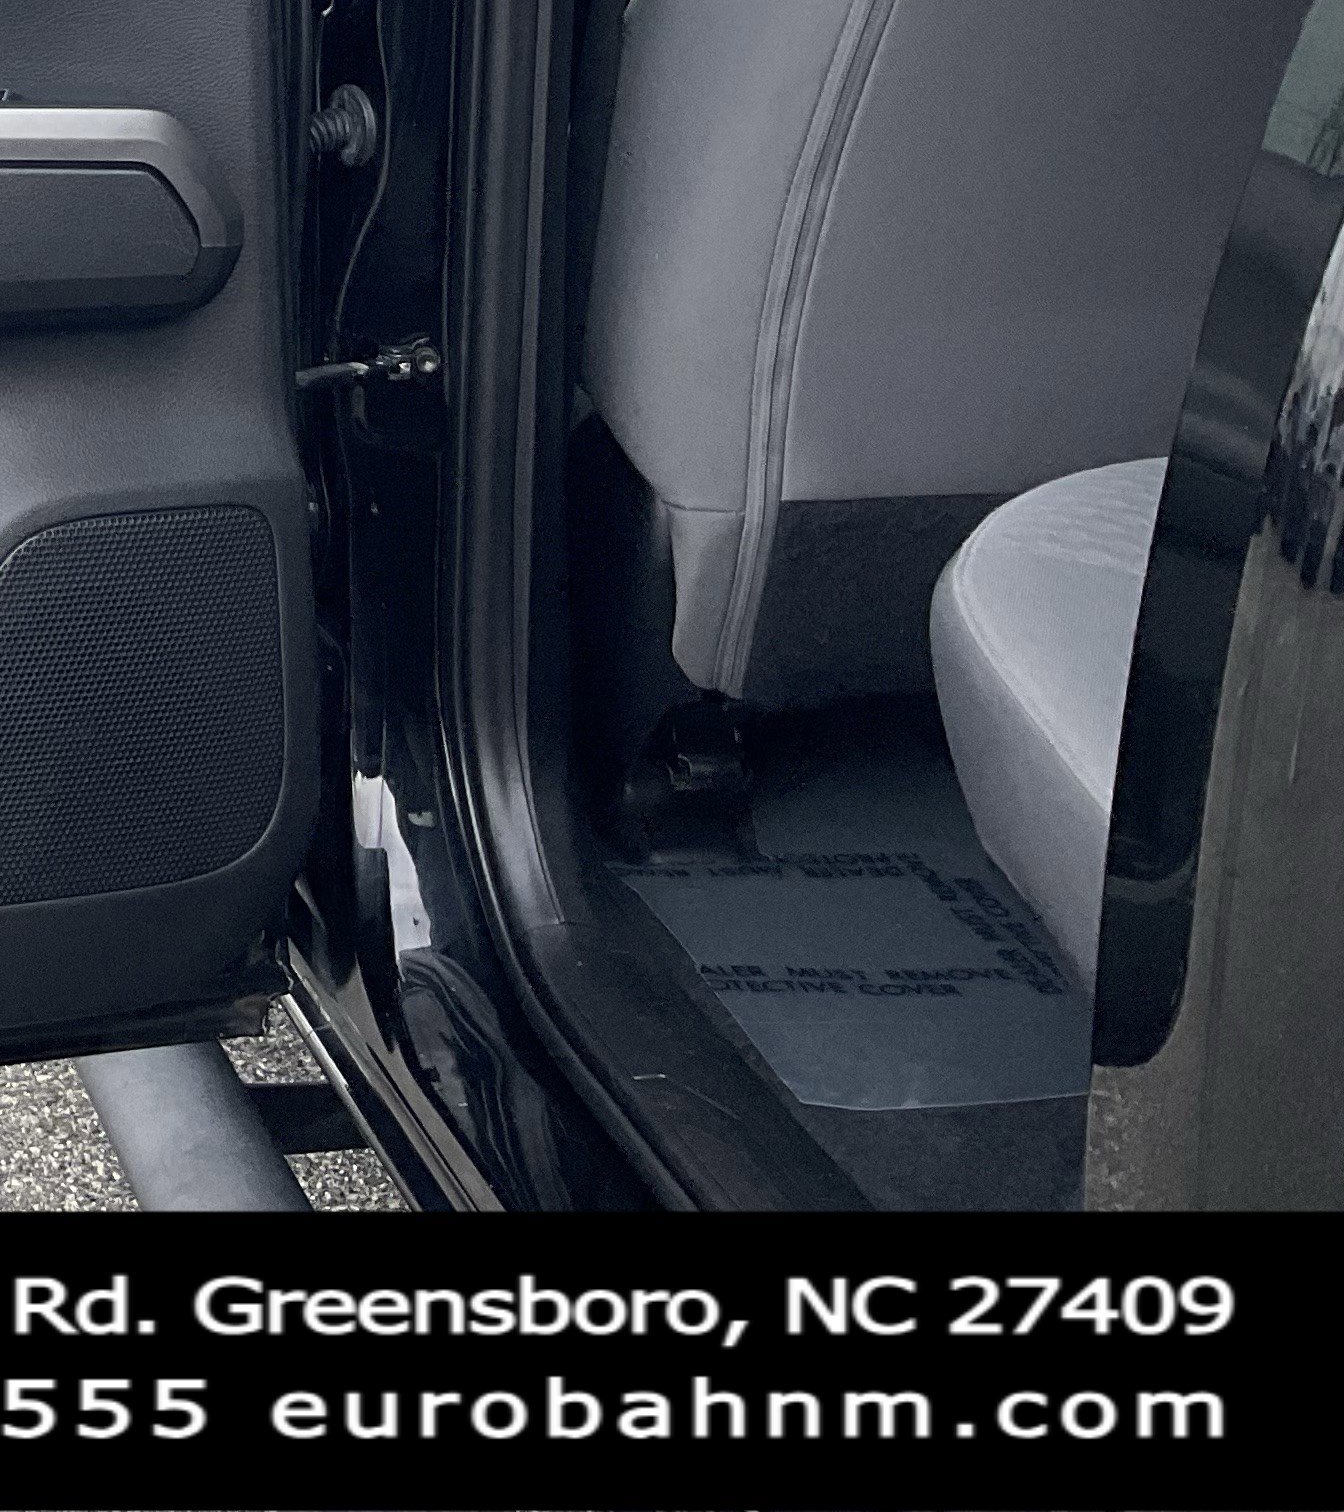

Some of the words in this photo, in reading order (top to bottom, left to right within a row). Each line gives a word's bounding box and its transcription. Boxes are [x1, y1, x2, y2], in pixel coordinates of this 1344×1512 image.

[785, 966, 867, 980] MUST
[884, 967, 1011, 981] REMOVE
[859, 983, 962, 996] COVER
